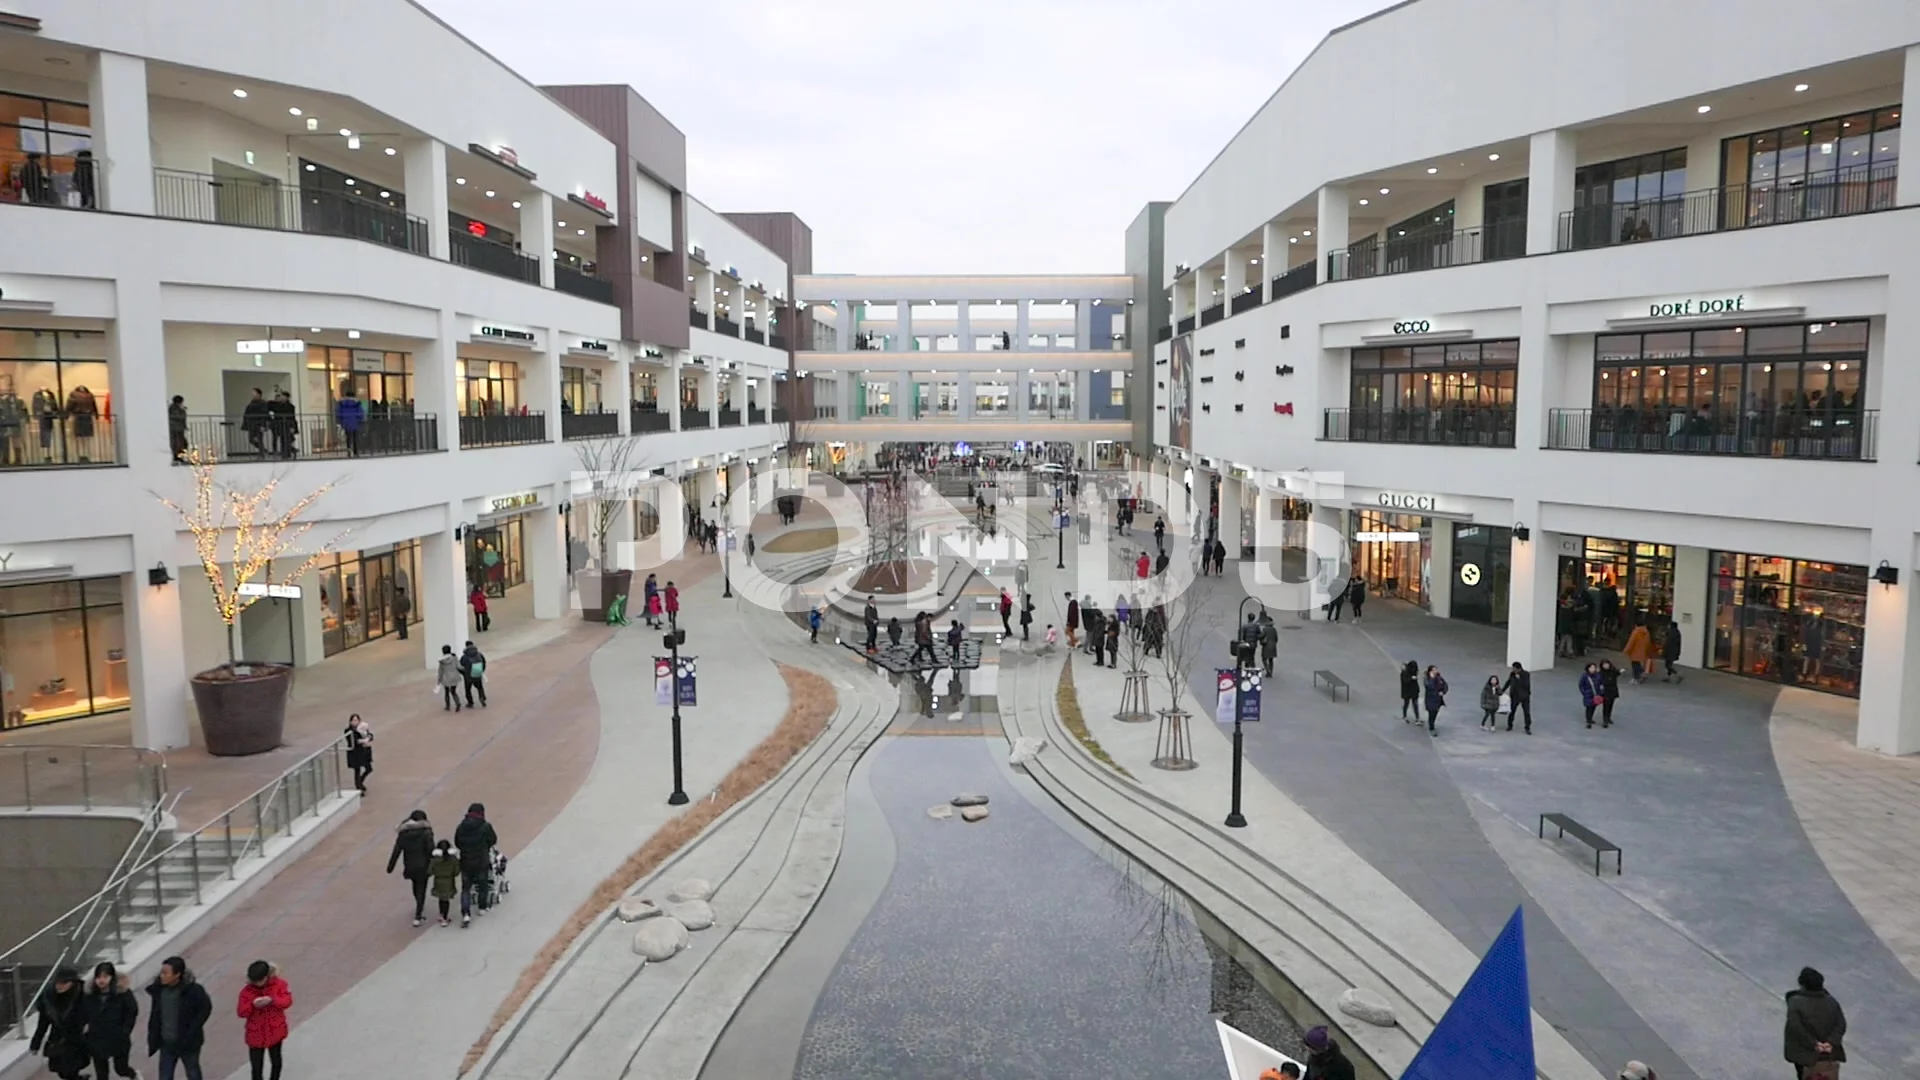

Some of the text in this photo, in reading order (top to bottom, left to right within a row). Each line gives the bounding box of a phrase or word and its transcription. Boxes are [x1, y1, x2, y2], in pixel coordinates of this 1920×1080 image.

[1650, 295, 1745, 317] DORÉ DORÉ
[1393, 320, 1430, 334] ecco
[1377, 492, 1436, 511] GUCCI
